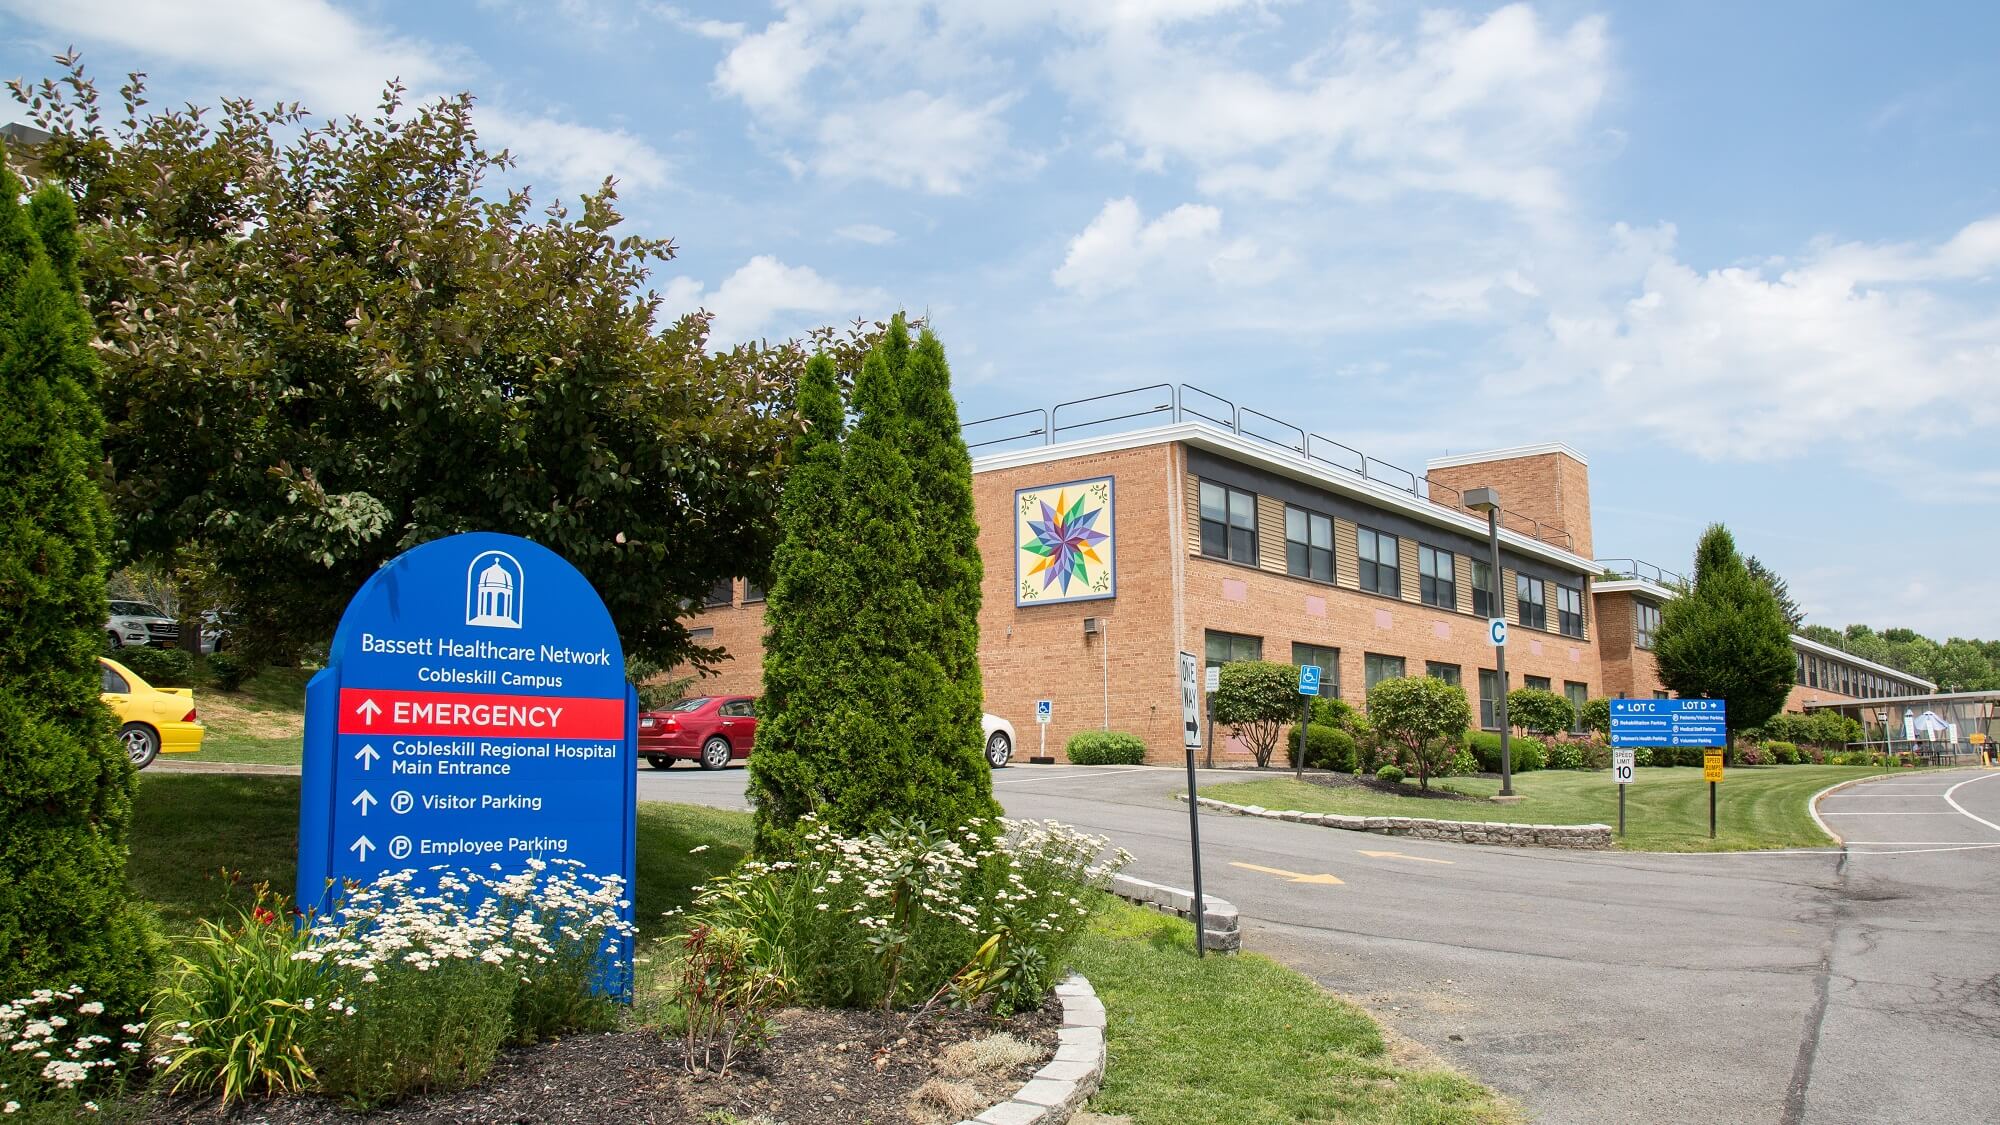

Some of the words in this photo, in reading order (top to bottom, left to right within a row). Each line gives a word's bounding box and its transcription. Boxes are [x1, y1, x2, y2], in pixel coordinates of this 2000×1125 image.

[1492, 621, 1505, 643] C
[361, 633, 433, 656] Bassett
[438, 638, 536, 662] Healthcare
[540, 644, 611, 666] Network
[418, 667, 497, 685] Cobleskill
[501, 671, 563, 689] Campus
[1182, 660, 1195, 684] ONE
[1184, 687, 1196, 710] WAY
[1627, 703, 1646, 712] LOT
[1648, 703, 1656, 712] C
[1682, 701, 1698, 710] LOT
[1700, 701, 1707, 710] D
[393, 702, 564, 728] EMERGENCY
[392, 741, 475, 757] Cobleskill
[480, 743, 551, 760] Regional
[555, 744, 617, 761] Hospital
[392, 760, 432, 775] Main
[438, 761, 511, 775] Entrance
[1616, 766, 1632, 779] 10
[421, 794, 477, 810] Visitor
[481, 794, 542, 811] Parking
[420, 838, 504, 856] Employee
[508, 836, 568, 853] Parking
